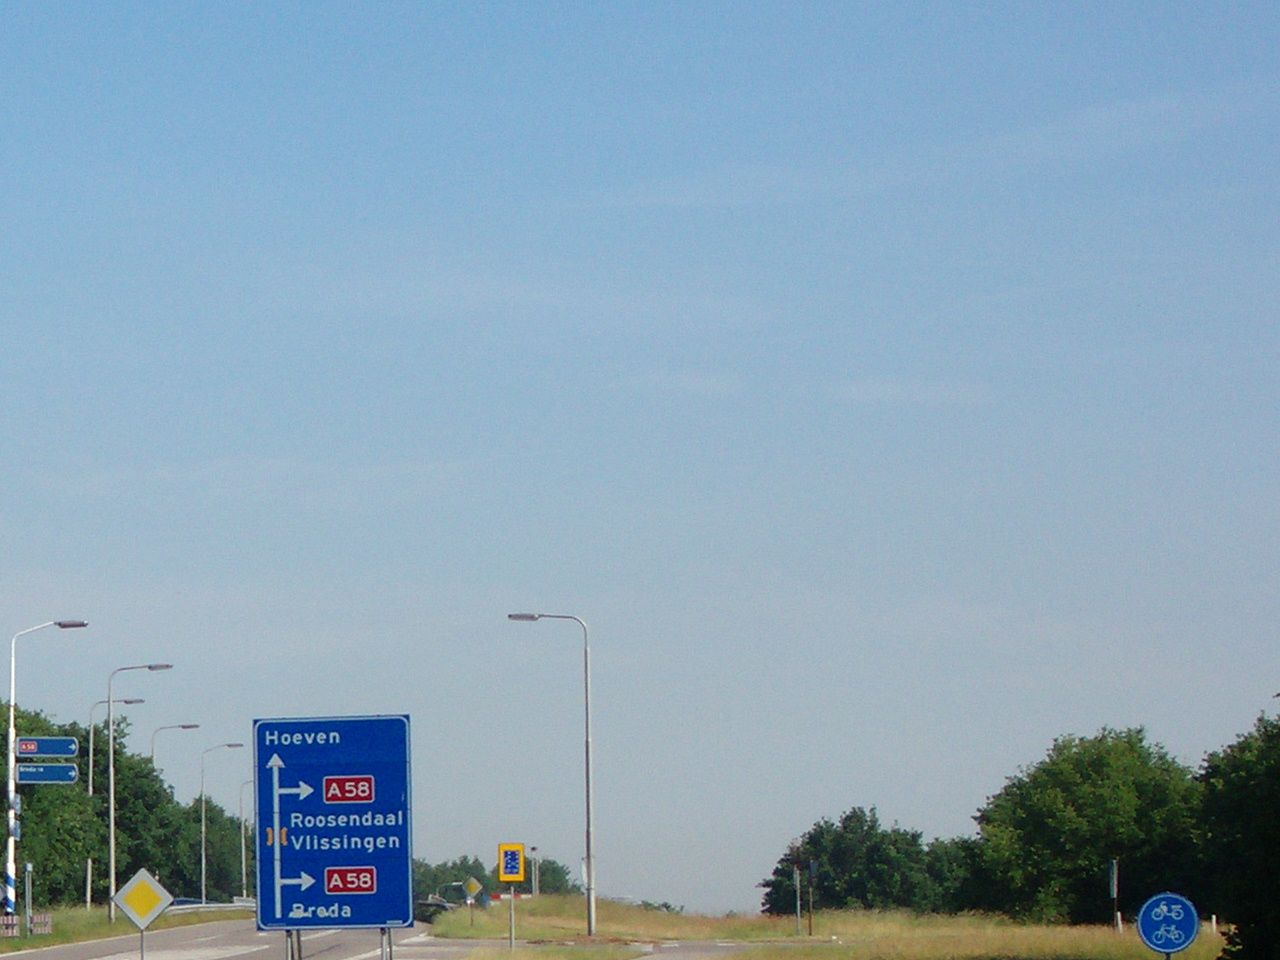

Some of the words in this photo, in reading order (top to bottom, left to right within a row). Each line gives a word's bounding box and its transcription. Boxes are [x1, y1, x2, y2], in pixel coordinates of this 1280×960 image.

[265, 730, 340, 746] Hoeven
[290, 810, 403, 828] Roosendaal
[290, 834, 400, 853] Vlissingen
